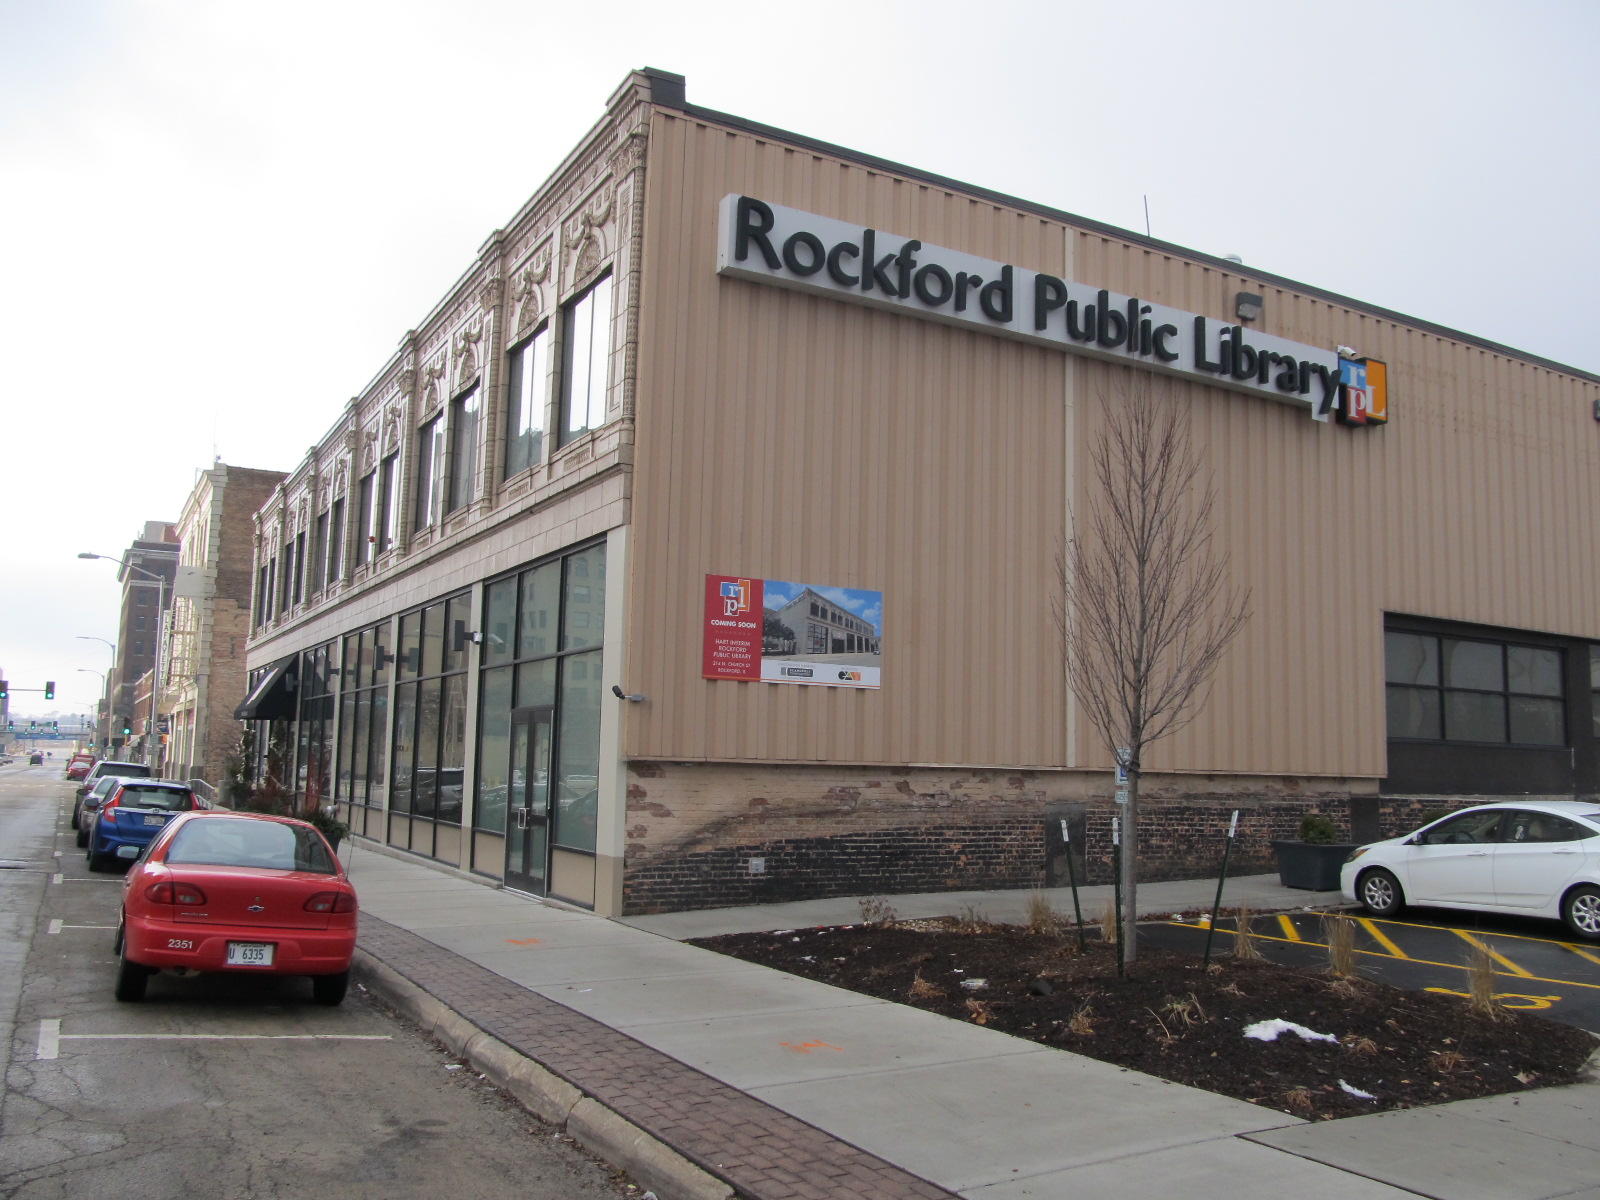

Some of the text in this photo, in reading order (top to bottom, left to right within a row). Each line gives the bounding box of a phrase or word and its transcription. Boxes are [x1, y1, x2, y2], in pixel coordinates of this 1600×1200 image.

[734, 194, 1343, 415] Rockford Public Library
[711, 619, 737, 627] COMING
[168, 939, 193, 949] 2351
[229, 948, 265, 960] U 6335
